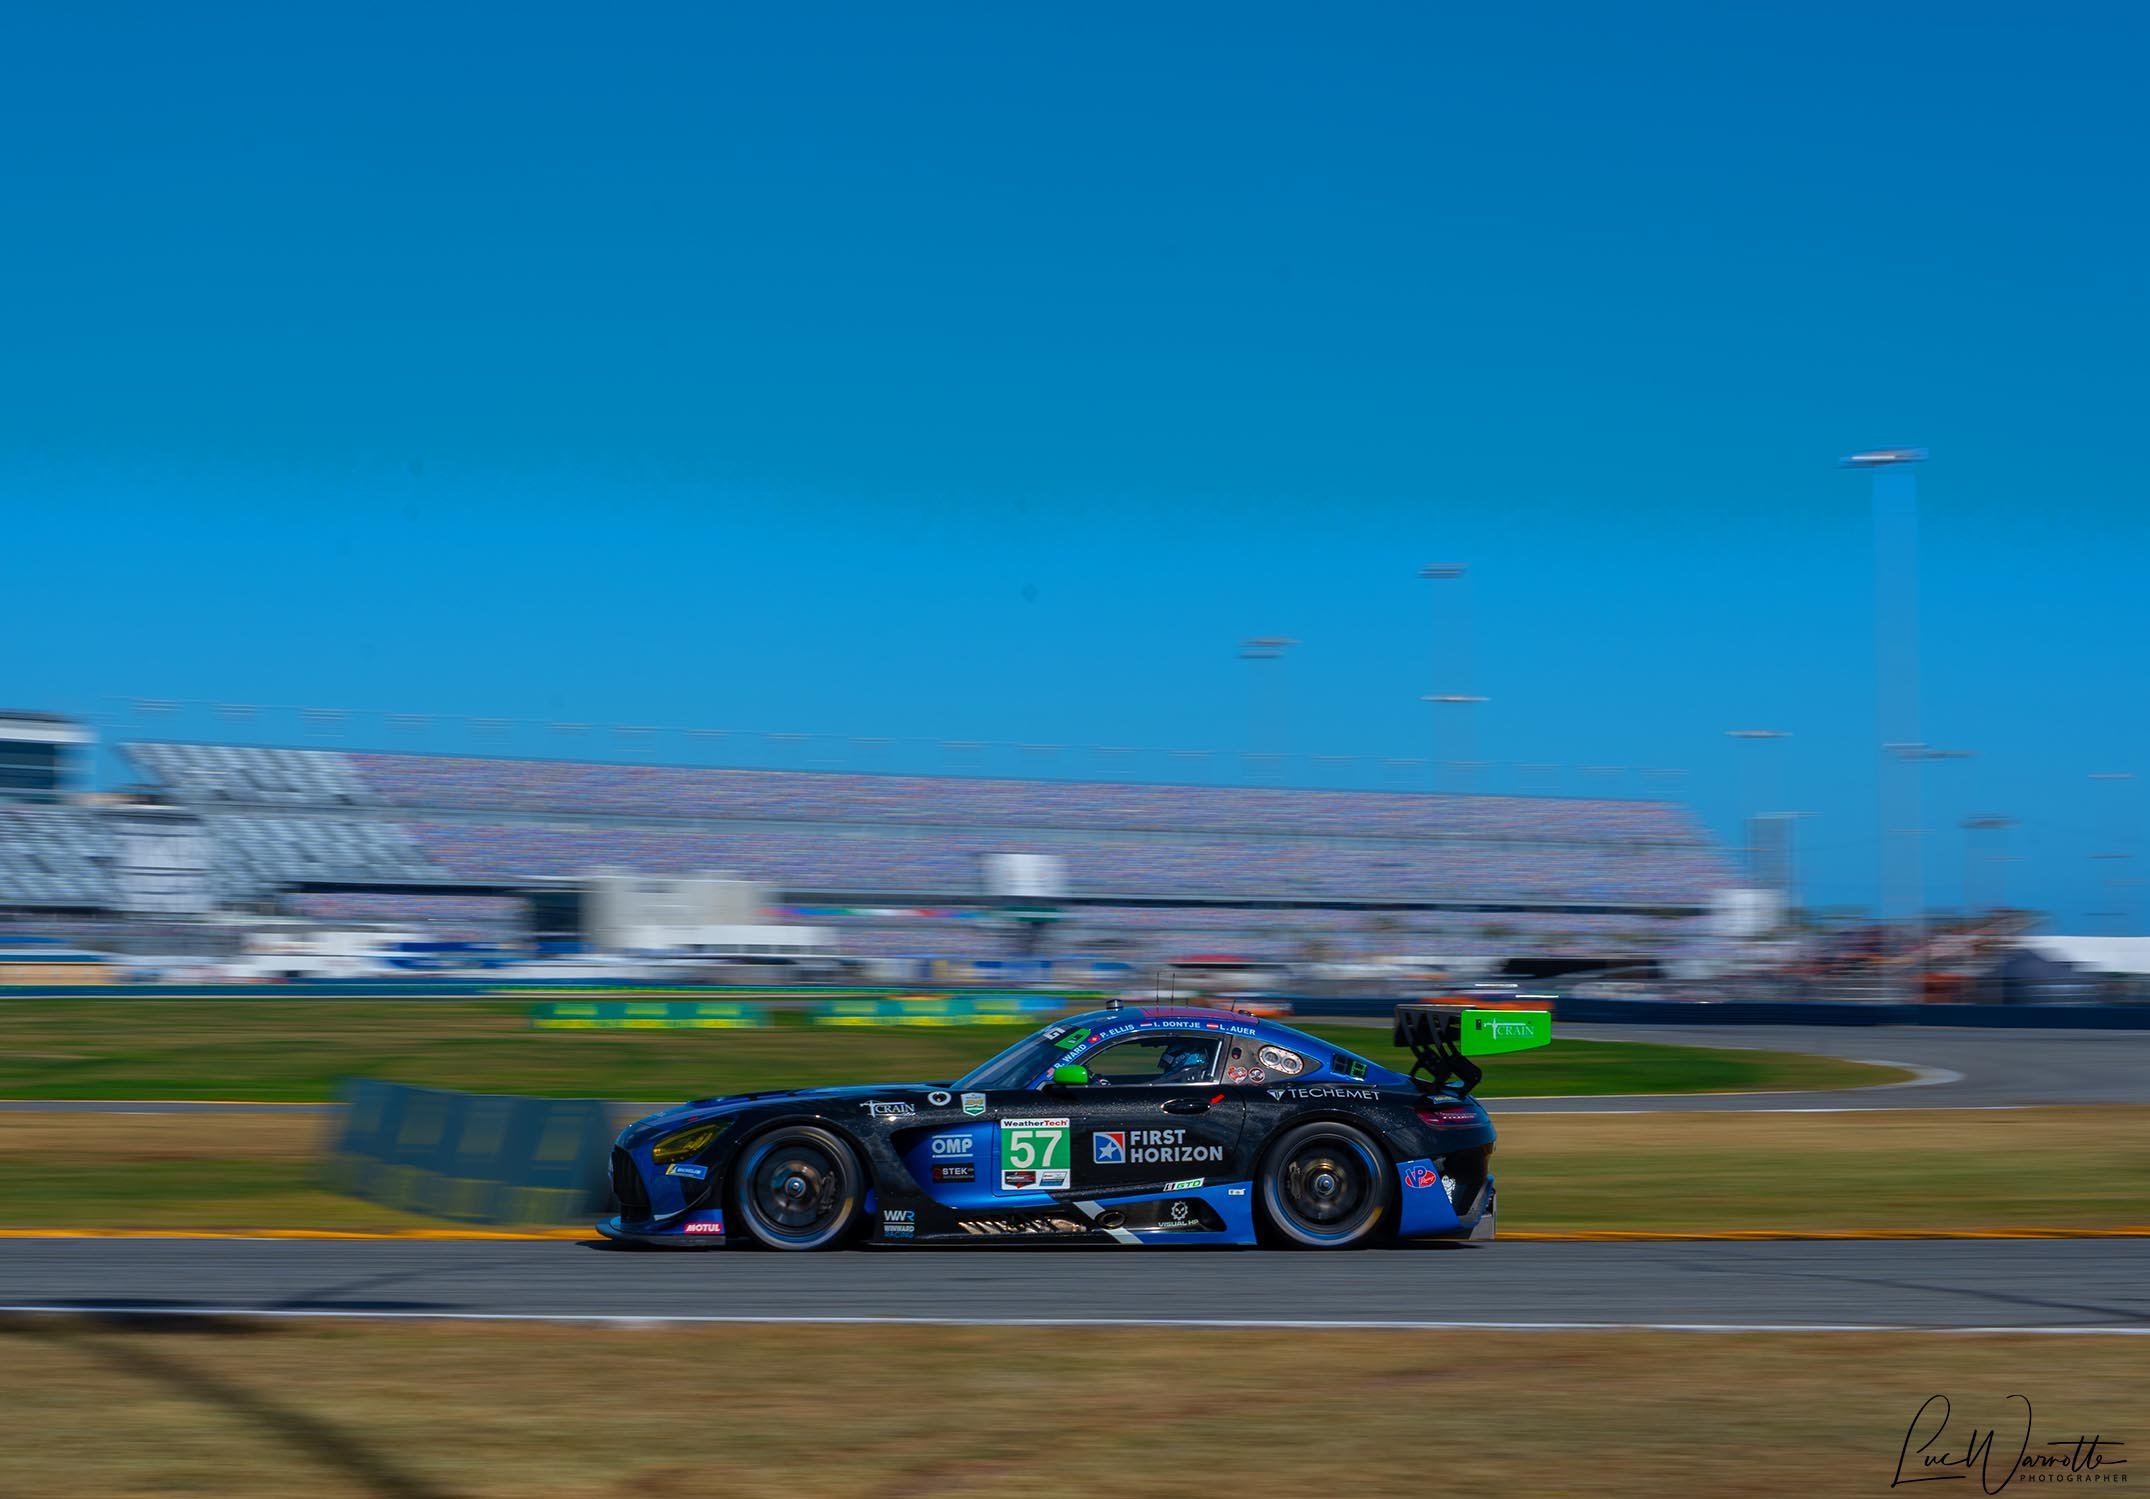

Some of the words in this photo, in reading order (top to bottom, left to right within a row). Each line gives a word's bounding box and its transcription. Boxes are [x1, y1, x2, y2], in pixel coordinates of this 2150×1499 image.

[1162, 1021, 1201, 1029] DONTJE
[1219, 1024, 1229, 1032] L.
[1230, 1025, 1256, 1035] AUER
[1100, 1030, 1109, 1039] P.
[1110, 1024, 1135, 1037] ELLIS
[1062, 1044, 1087, 1062] WARD
[1288, 1088, 1380, 1100] TECHEMET
[1003, 1119, 1068, 1127] WeatherTech
[1130, 1129, 1186, 1145] FIRST
[932, 1138, 973, 1154] OMP
[1010, 1130, 1063, 1168] 57
[1131, 1146, 1223, 1163] HORIZON
[942, 1167, 969, 1175] STEK
[1176, 1180, 1201, 1189] GTD
[686, 1223, 721, 1232] MOTUL
[1158, 1220, 1187, 1228] VISUAL
